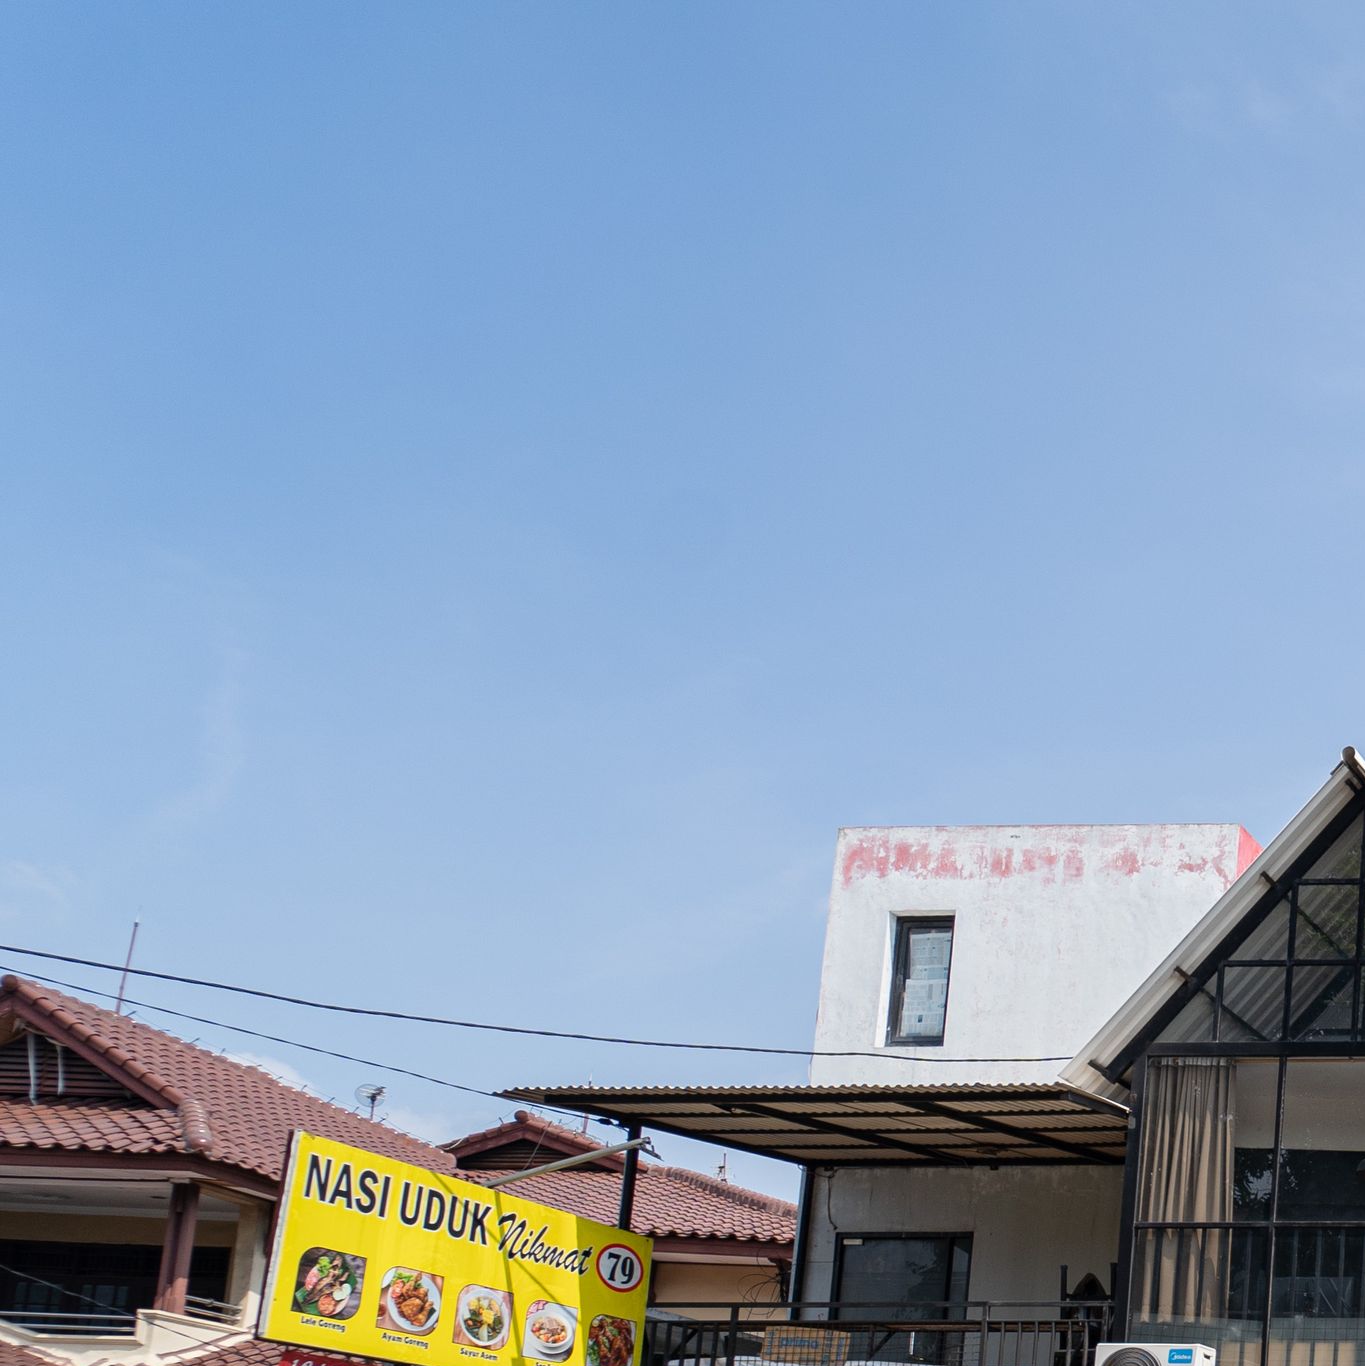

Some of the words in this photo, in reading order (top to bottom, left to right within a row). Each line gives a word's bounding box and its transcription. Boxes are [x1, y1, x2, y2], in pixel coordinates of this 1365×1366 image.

[303, 1152, 392, 1219] NASI
[399, 1180, 492, 1246] UDUK
[497, 1212, 593, 1276] Nikmat
[606, 1251, 635, 1285] 79
[300, 1315, 316, 1327] Lele
[318, 1319, 346, 1333] Goreng
[381, 1332, 403, 1343] Ayam
[403, 1336, 429, 1349] Goreng
[459, 1347, 480, 1361] Sayur
[480, 1350, 498, 1361] Asem
